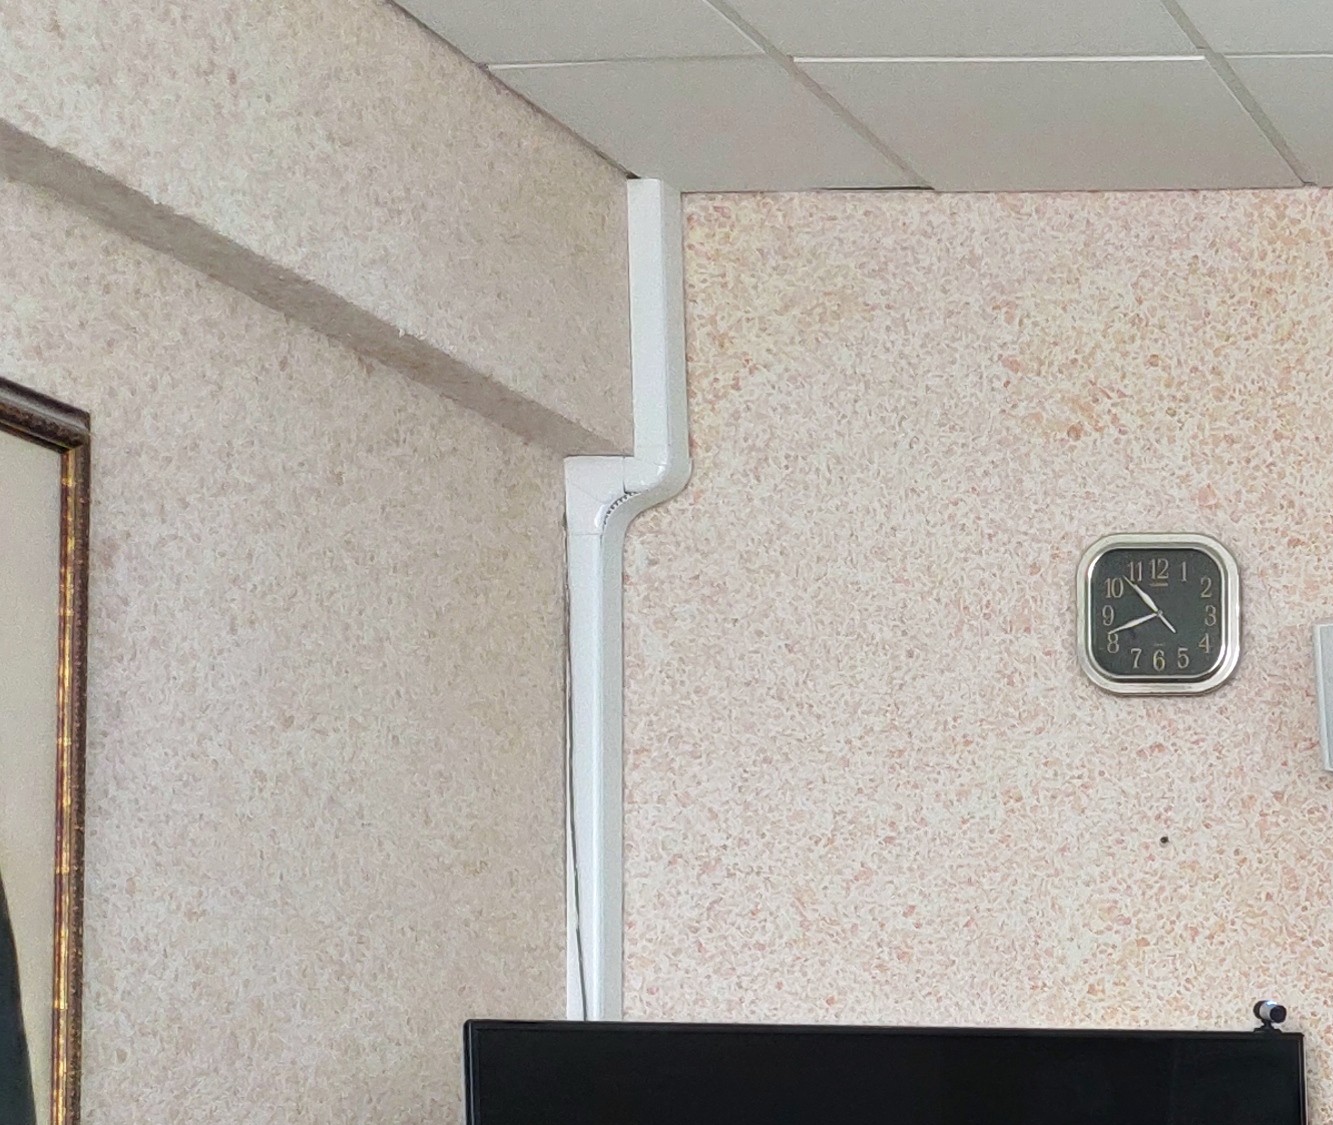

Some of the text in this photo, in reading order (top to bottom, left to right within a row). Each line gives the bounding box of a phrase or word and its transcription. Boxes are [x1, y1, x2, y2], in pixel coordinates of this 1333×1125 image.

[1128, 561, 1143, 582] 11
[1150, 558, 1169, 579] 12
[1180, 561, 1188, 582] 1
[1105, 577, 1124, 598] 10
[1200, 577, 1212, 598] 2
[1102, 605, 1115, 626] 9
[1204, 605, 1217, 626] 3
[1107, 632, 1120, 654] 8
[1199, 632, 1211, 654] 4
[1131, 648, 1142, 669] 7
[1152, 650, 1166, 671] 6
[1177, 648, 1190, 669] 5
